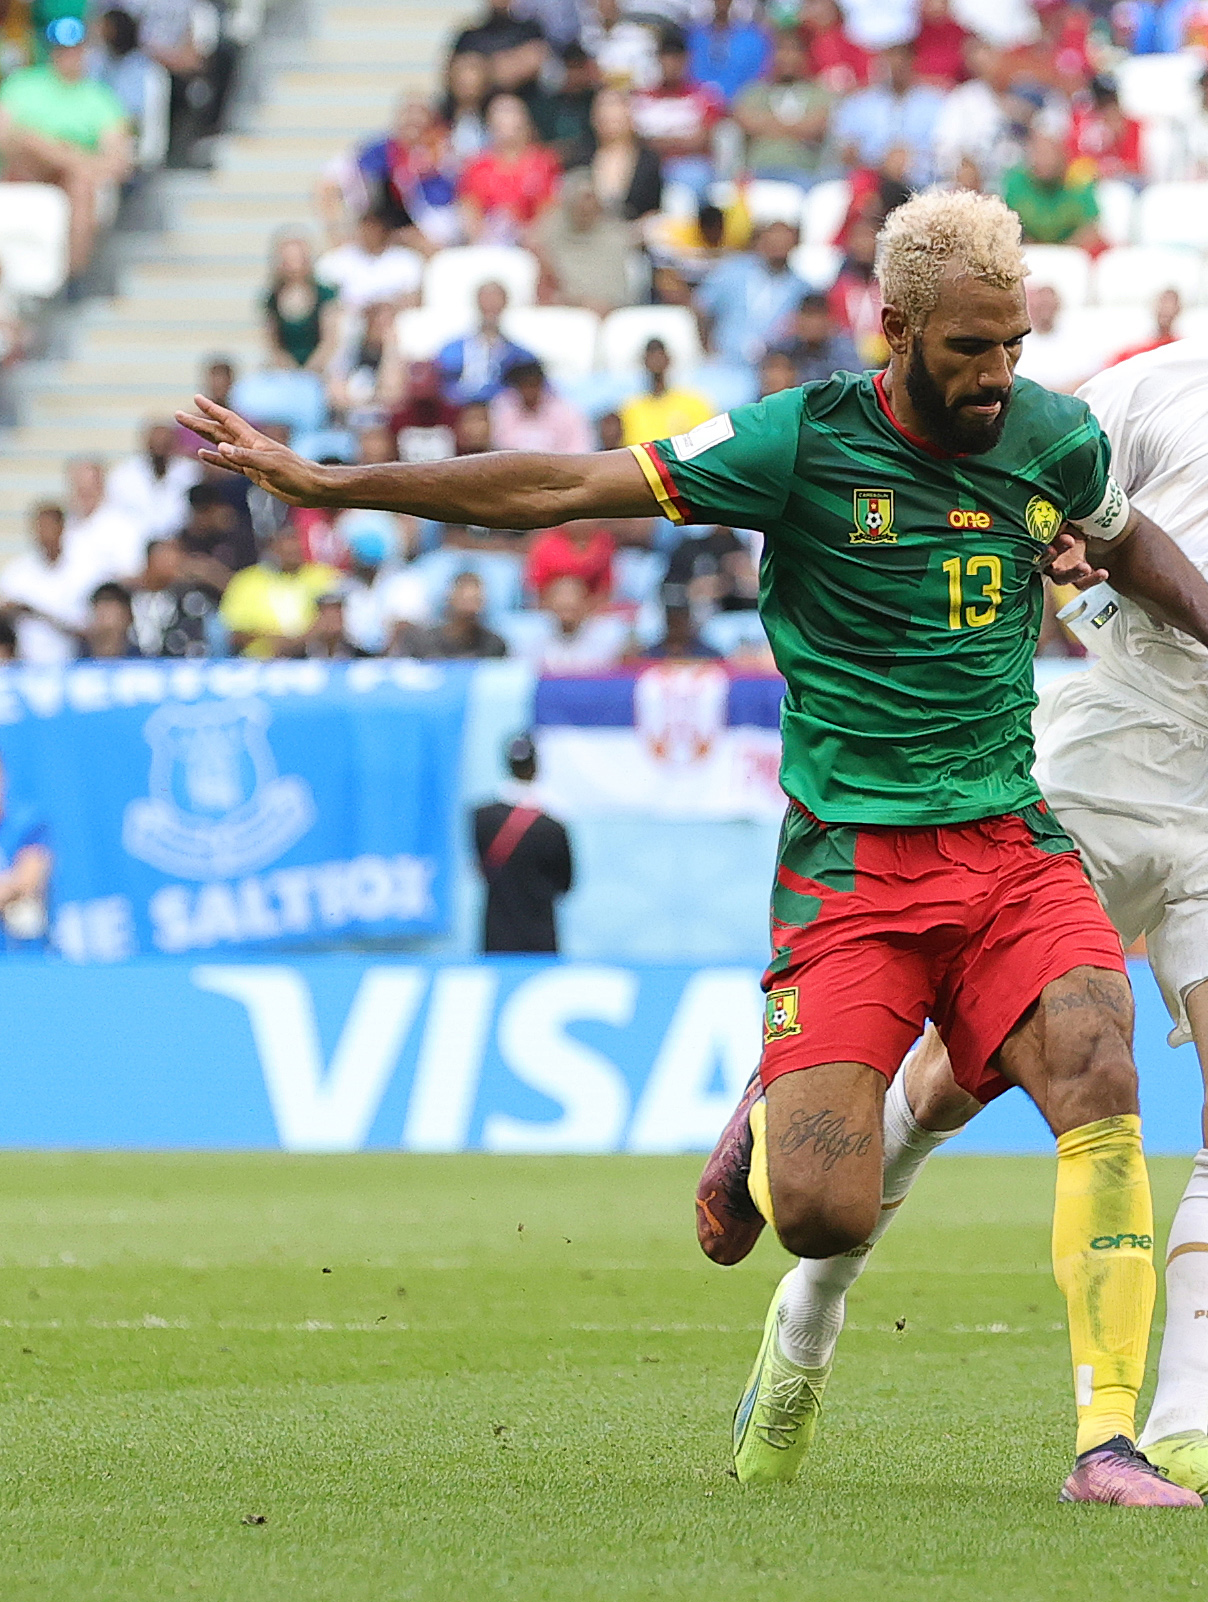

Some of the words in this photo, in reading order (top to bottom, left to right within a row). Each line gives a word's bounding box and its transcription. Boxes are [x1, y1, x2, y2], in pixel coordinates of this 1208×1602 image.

[948, 510, 991, 529] one
[942, 555, 1002, 630] 13
[190, 964, 768, 1154] VISA
[1089, 1233, 1153, 1250] one
